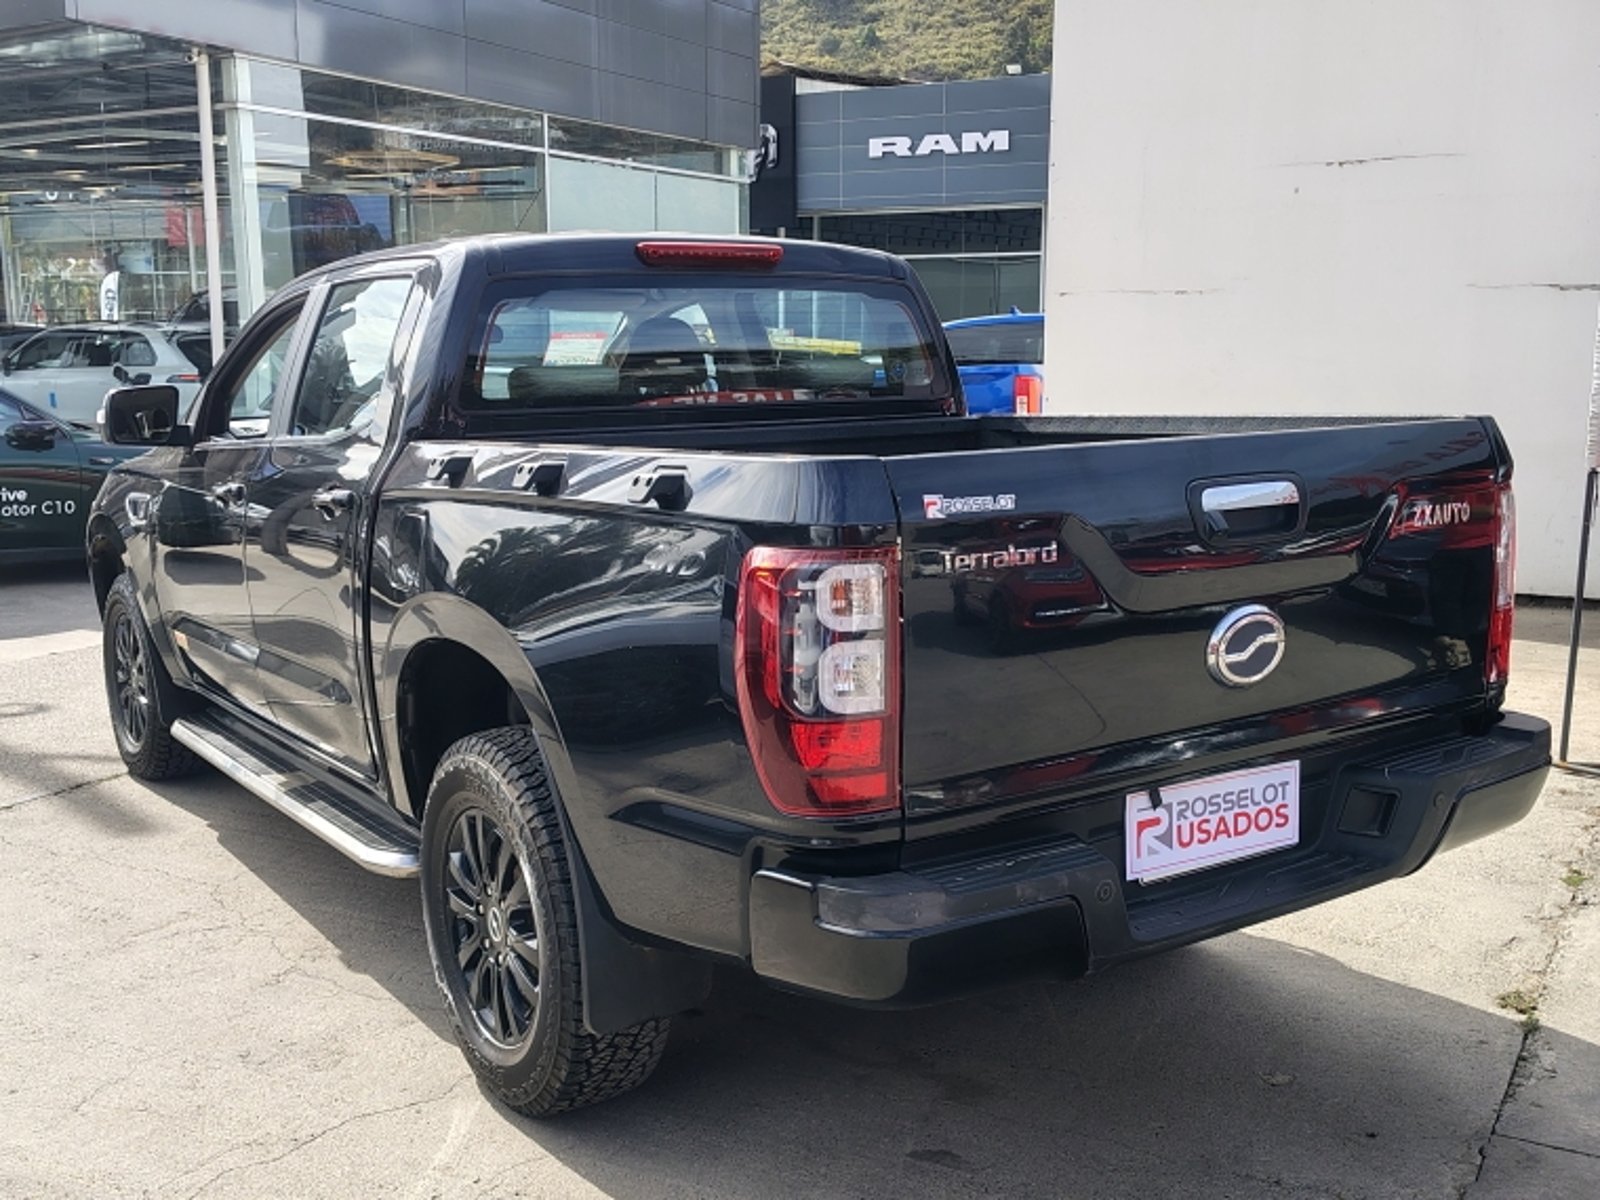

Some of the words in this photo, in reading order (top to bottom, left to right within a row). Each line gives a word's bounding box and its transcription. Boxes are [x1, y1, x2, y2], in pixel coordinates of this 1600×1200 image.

[868, 129, 1010, 159] RAM
[0, 487, 28, 502] ive
[1, 504, 37, 517] otor
[41, 500, 76, 515] C10
[1414, 501, 1471, 527] ZXAUTO
[940, 541, 1057, 573] Terralord
[1176, 781, 1290, 821] ROSSELOT
[1176, 803, 1290, 848] USADOS
